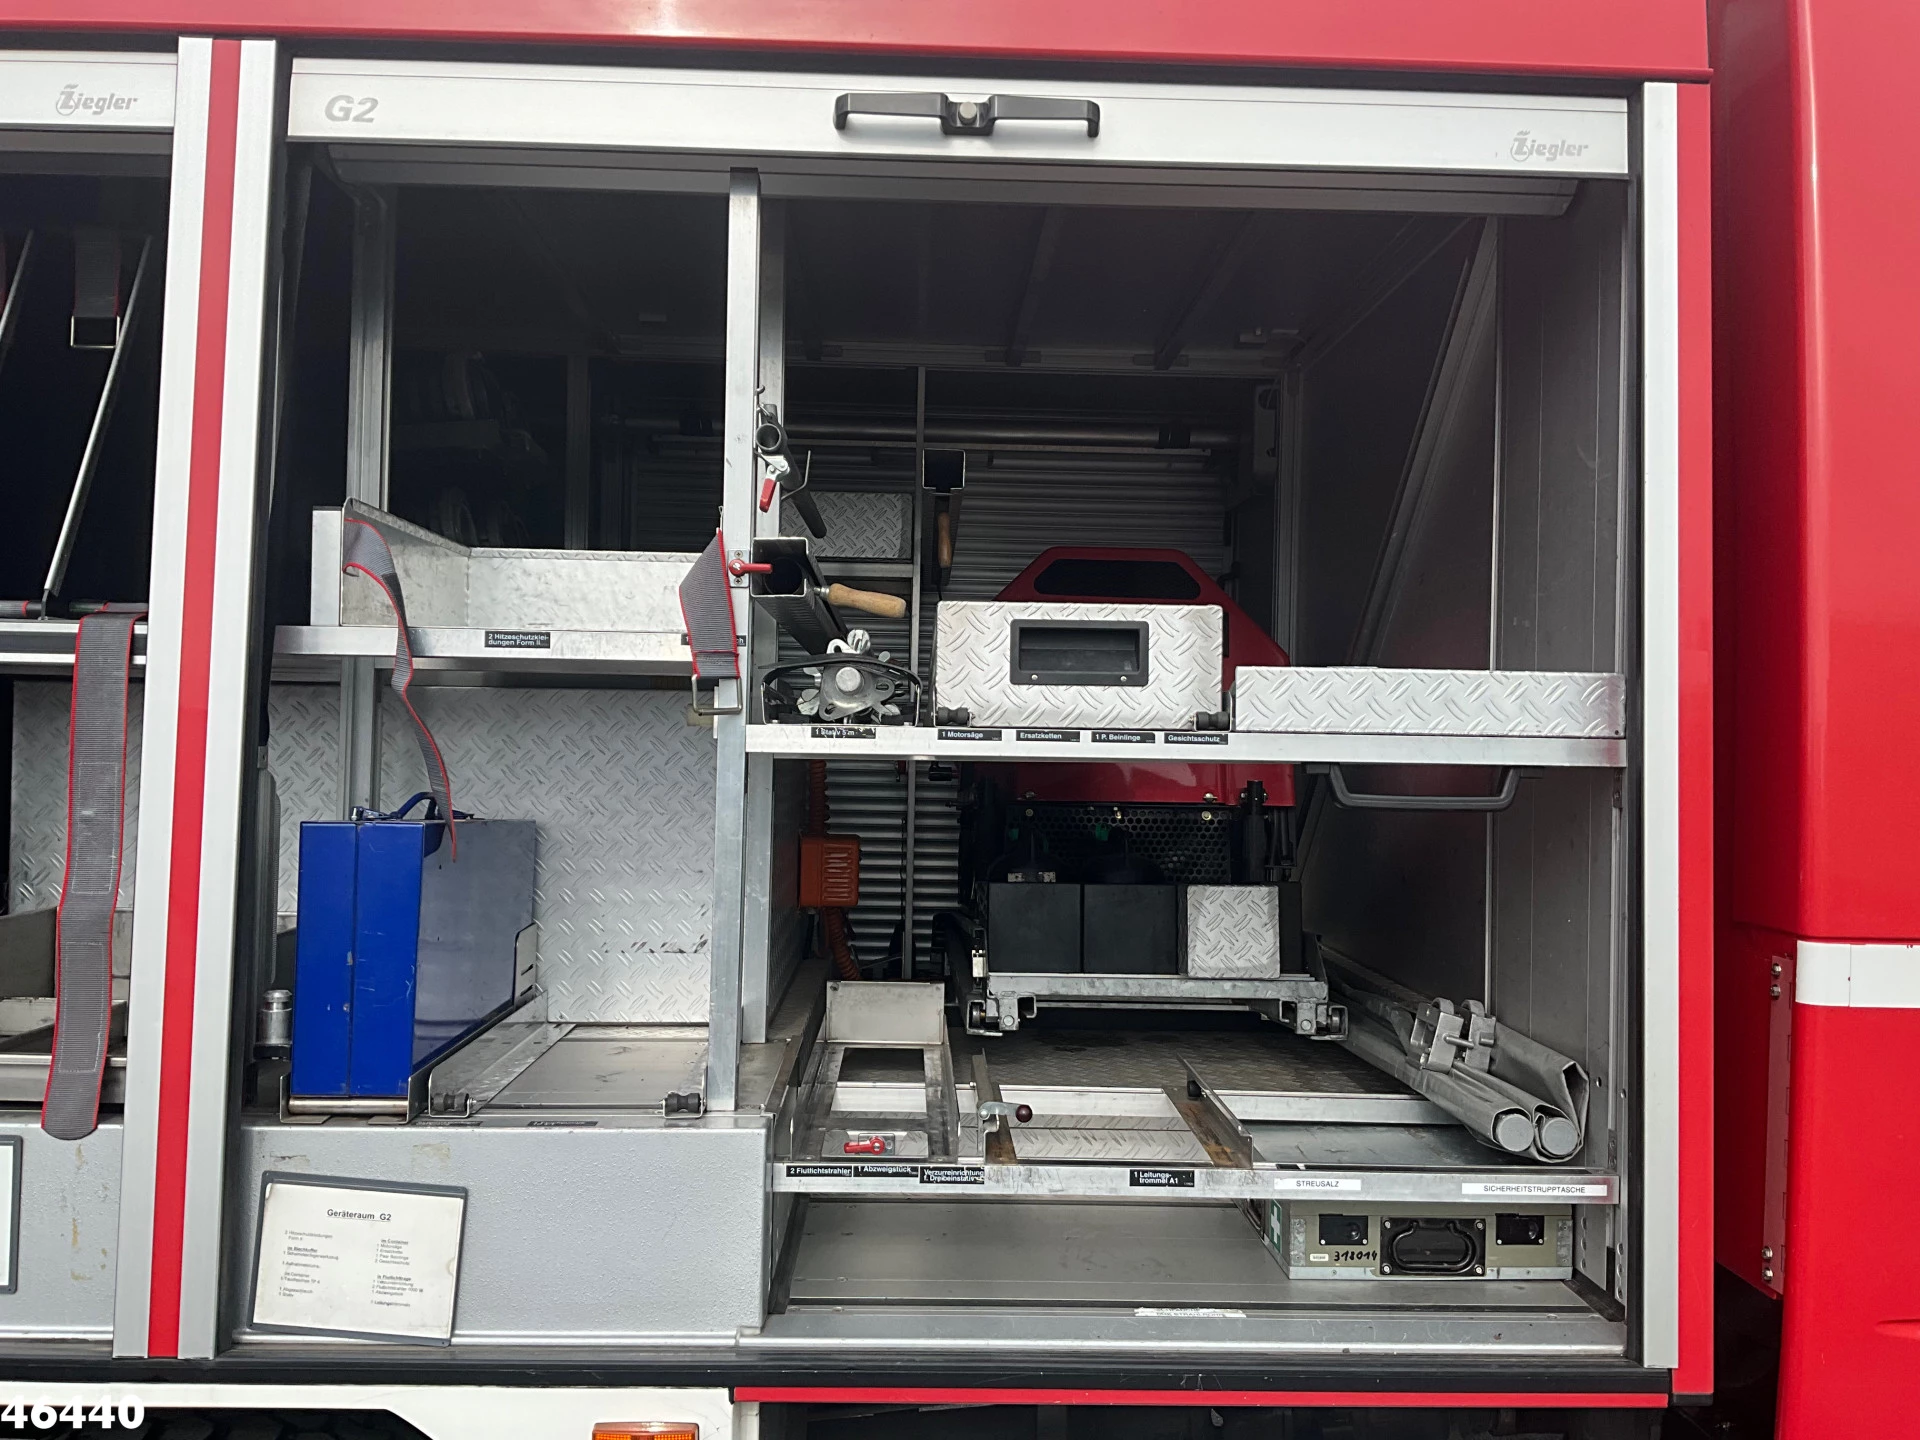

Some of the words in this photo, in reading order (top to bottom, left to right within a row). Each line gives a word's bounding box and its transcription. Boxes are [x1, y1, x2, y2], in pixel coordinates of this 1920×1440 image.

[325, 95, 379, 123] G2
[947, 731, 984, 739] Motorsäge
[1483, 1185, 1586, 1194] SICHERHEITSTRUPPTASCHE
[327, 1209, 375, 1219] Geräteraum
[379, 1213, 391, 1221] G2
